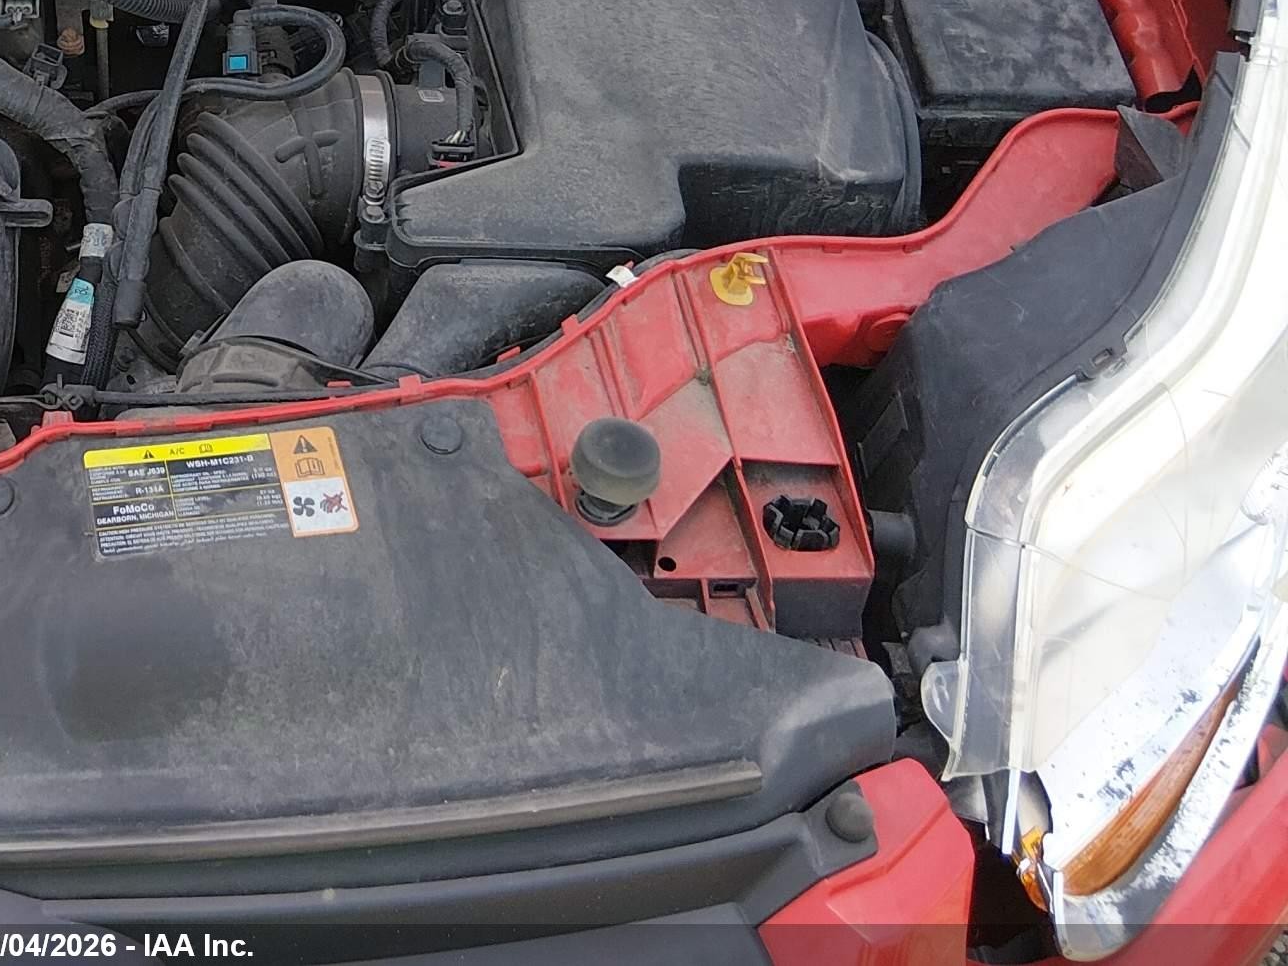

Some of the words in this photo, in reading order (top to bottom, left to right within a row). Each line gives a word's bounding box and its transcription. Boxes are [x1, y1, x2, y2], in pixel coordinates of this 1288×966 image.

[169, 447, 185, 455] A/C
[127, 468, 145, 477] SAE
[112, 503, 155, 515] FoMoCo
[96, 514, 139, 525] DEARBORN,
[139, 510, 175, 520] MICHIGAN
